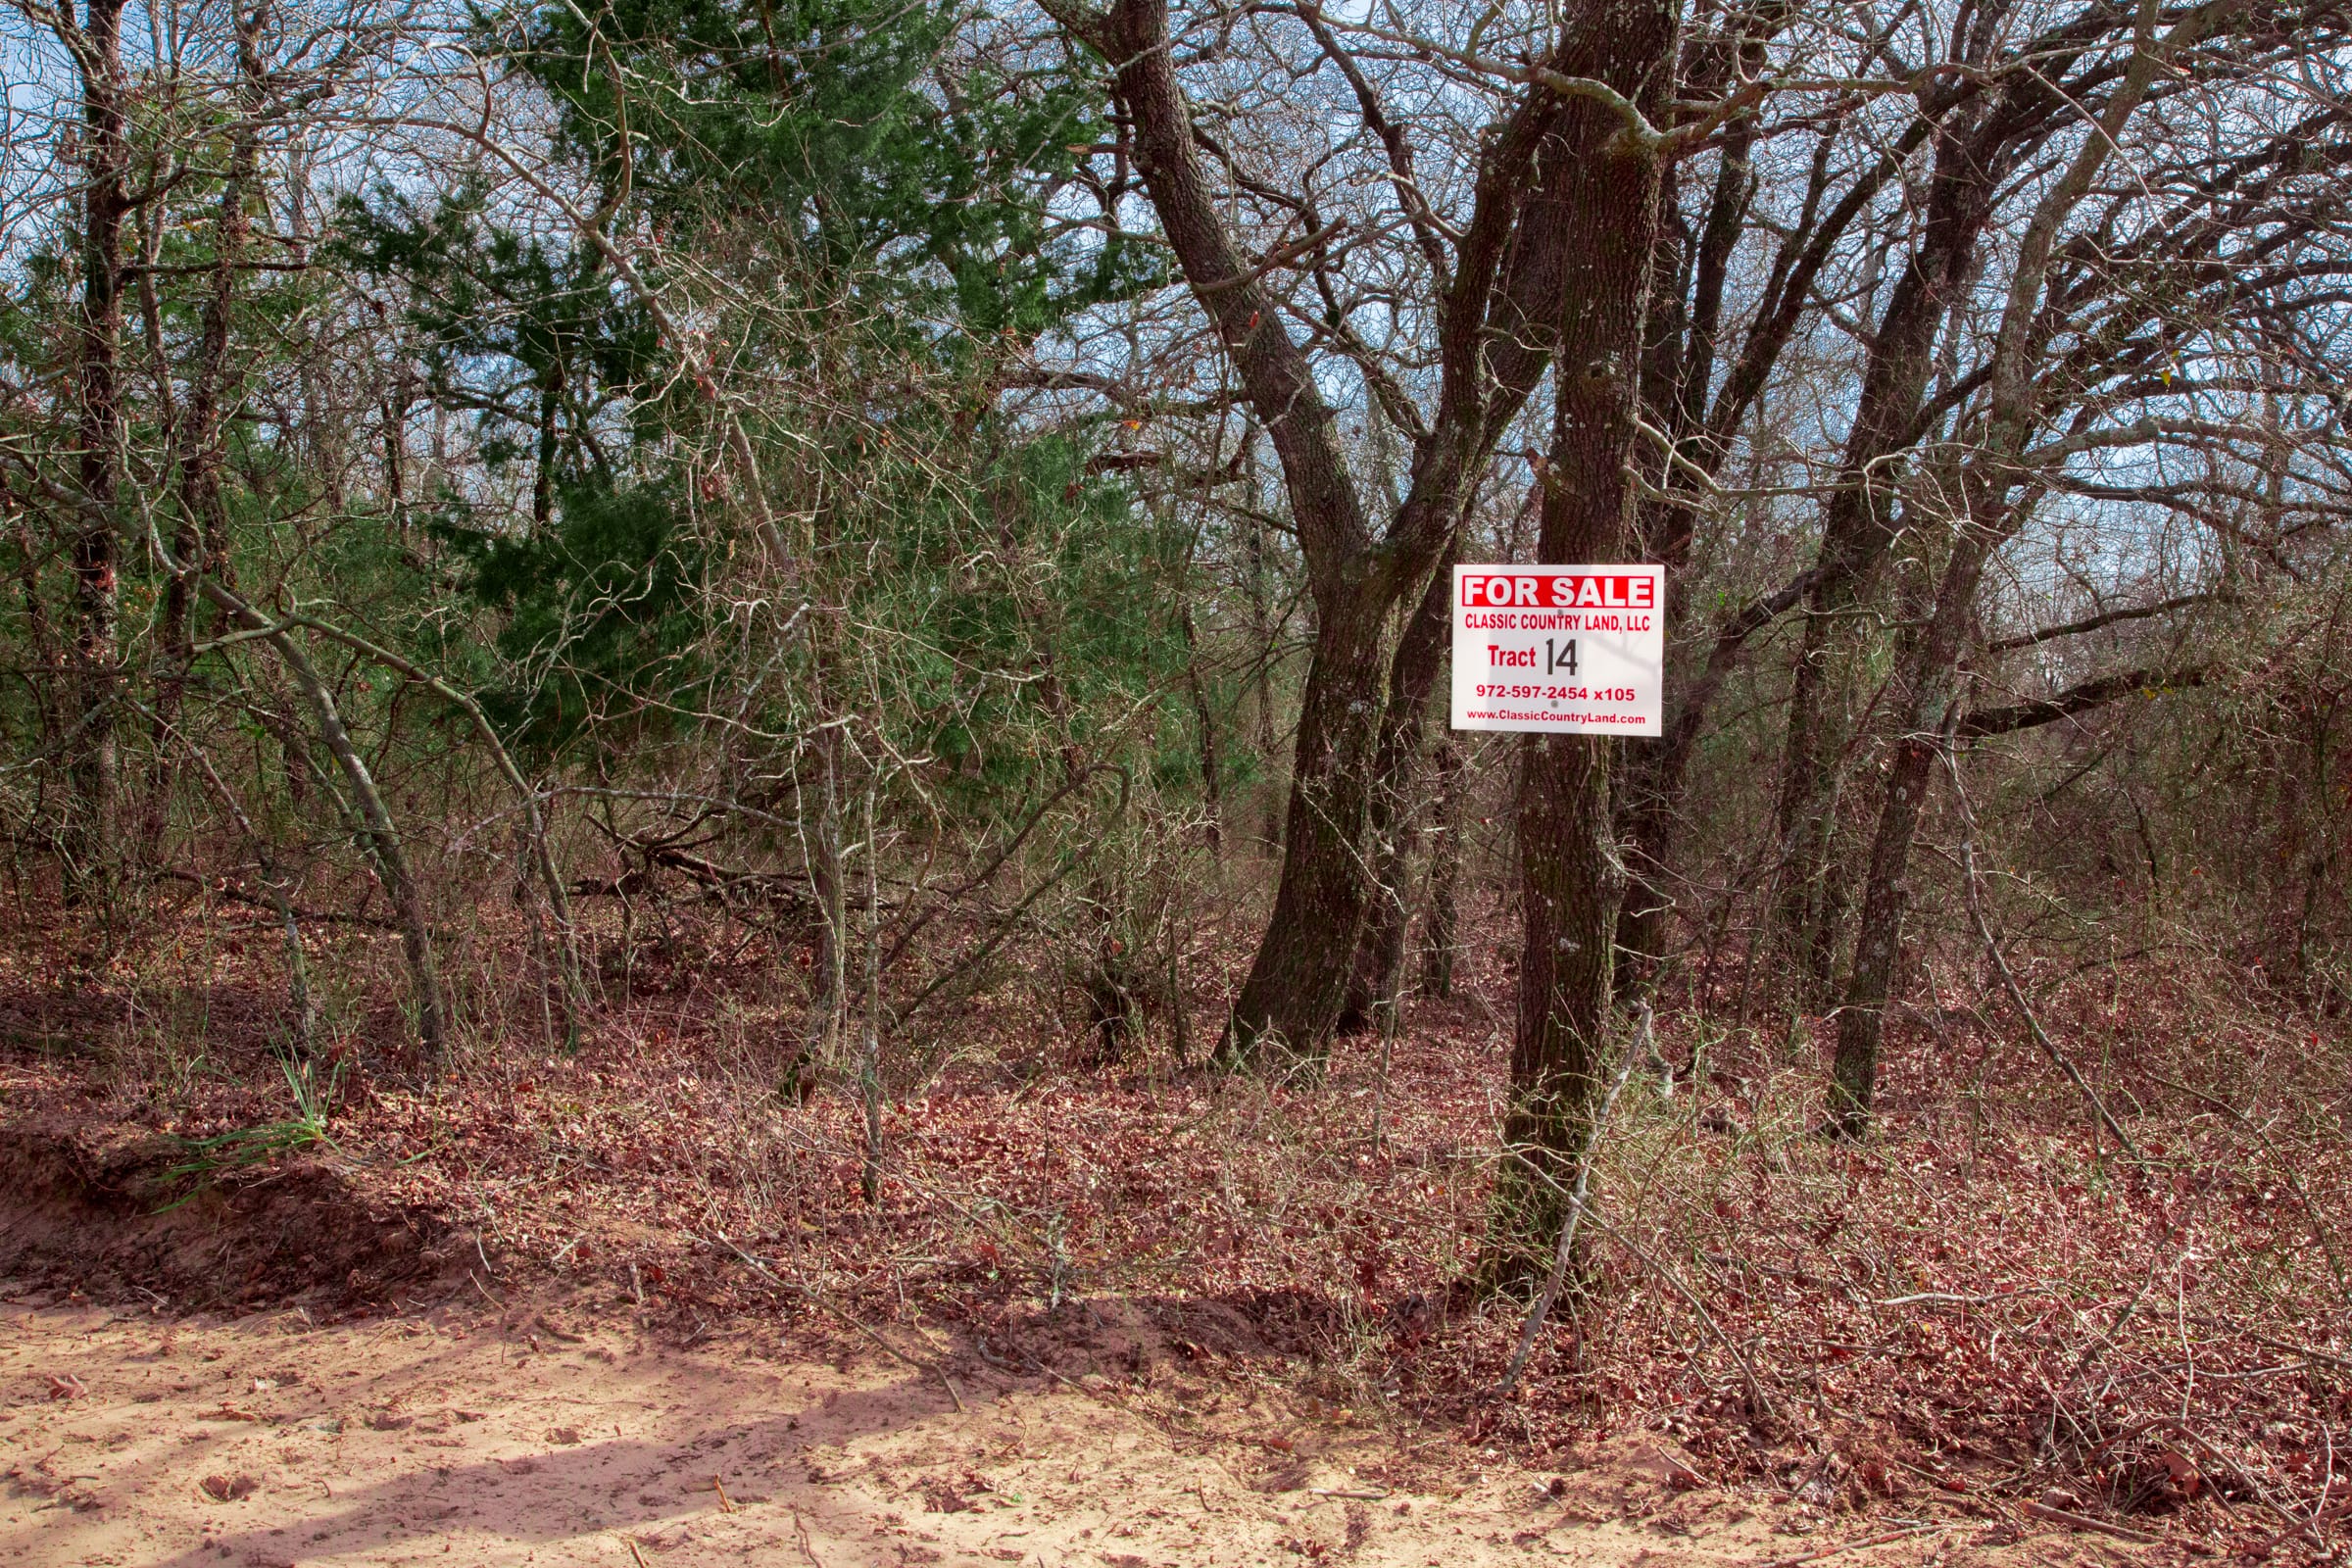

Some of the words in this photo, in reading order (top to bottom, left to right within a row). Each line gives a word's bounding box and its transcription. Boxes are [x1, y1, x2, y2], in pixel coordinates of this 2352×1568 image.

[1464, 577, 1540, 606] FOR
[1551, 577, 1650, 607] SALE
[1465, 614, 1516, 629] CLASSIC
[1521, 614, 1581, 629] COUNTRY
[1586, 615, 1622, 634] LAND,
[1627, 616, 1649, 631] LLC
[1488, 645, 1536, 666] Tract
[1545, 638, 1578, 675] 14
[1477, 685, 1588, 700] 972-597-2454
[1594, 689, 1635, 701] x105
[1467, 710, 1645, 724] www.ClassicCountryLand.com
